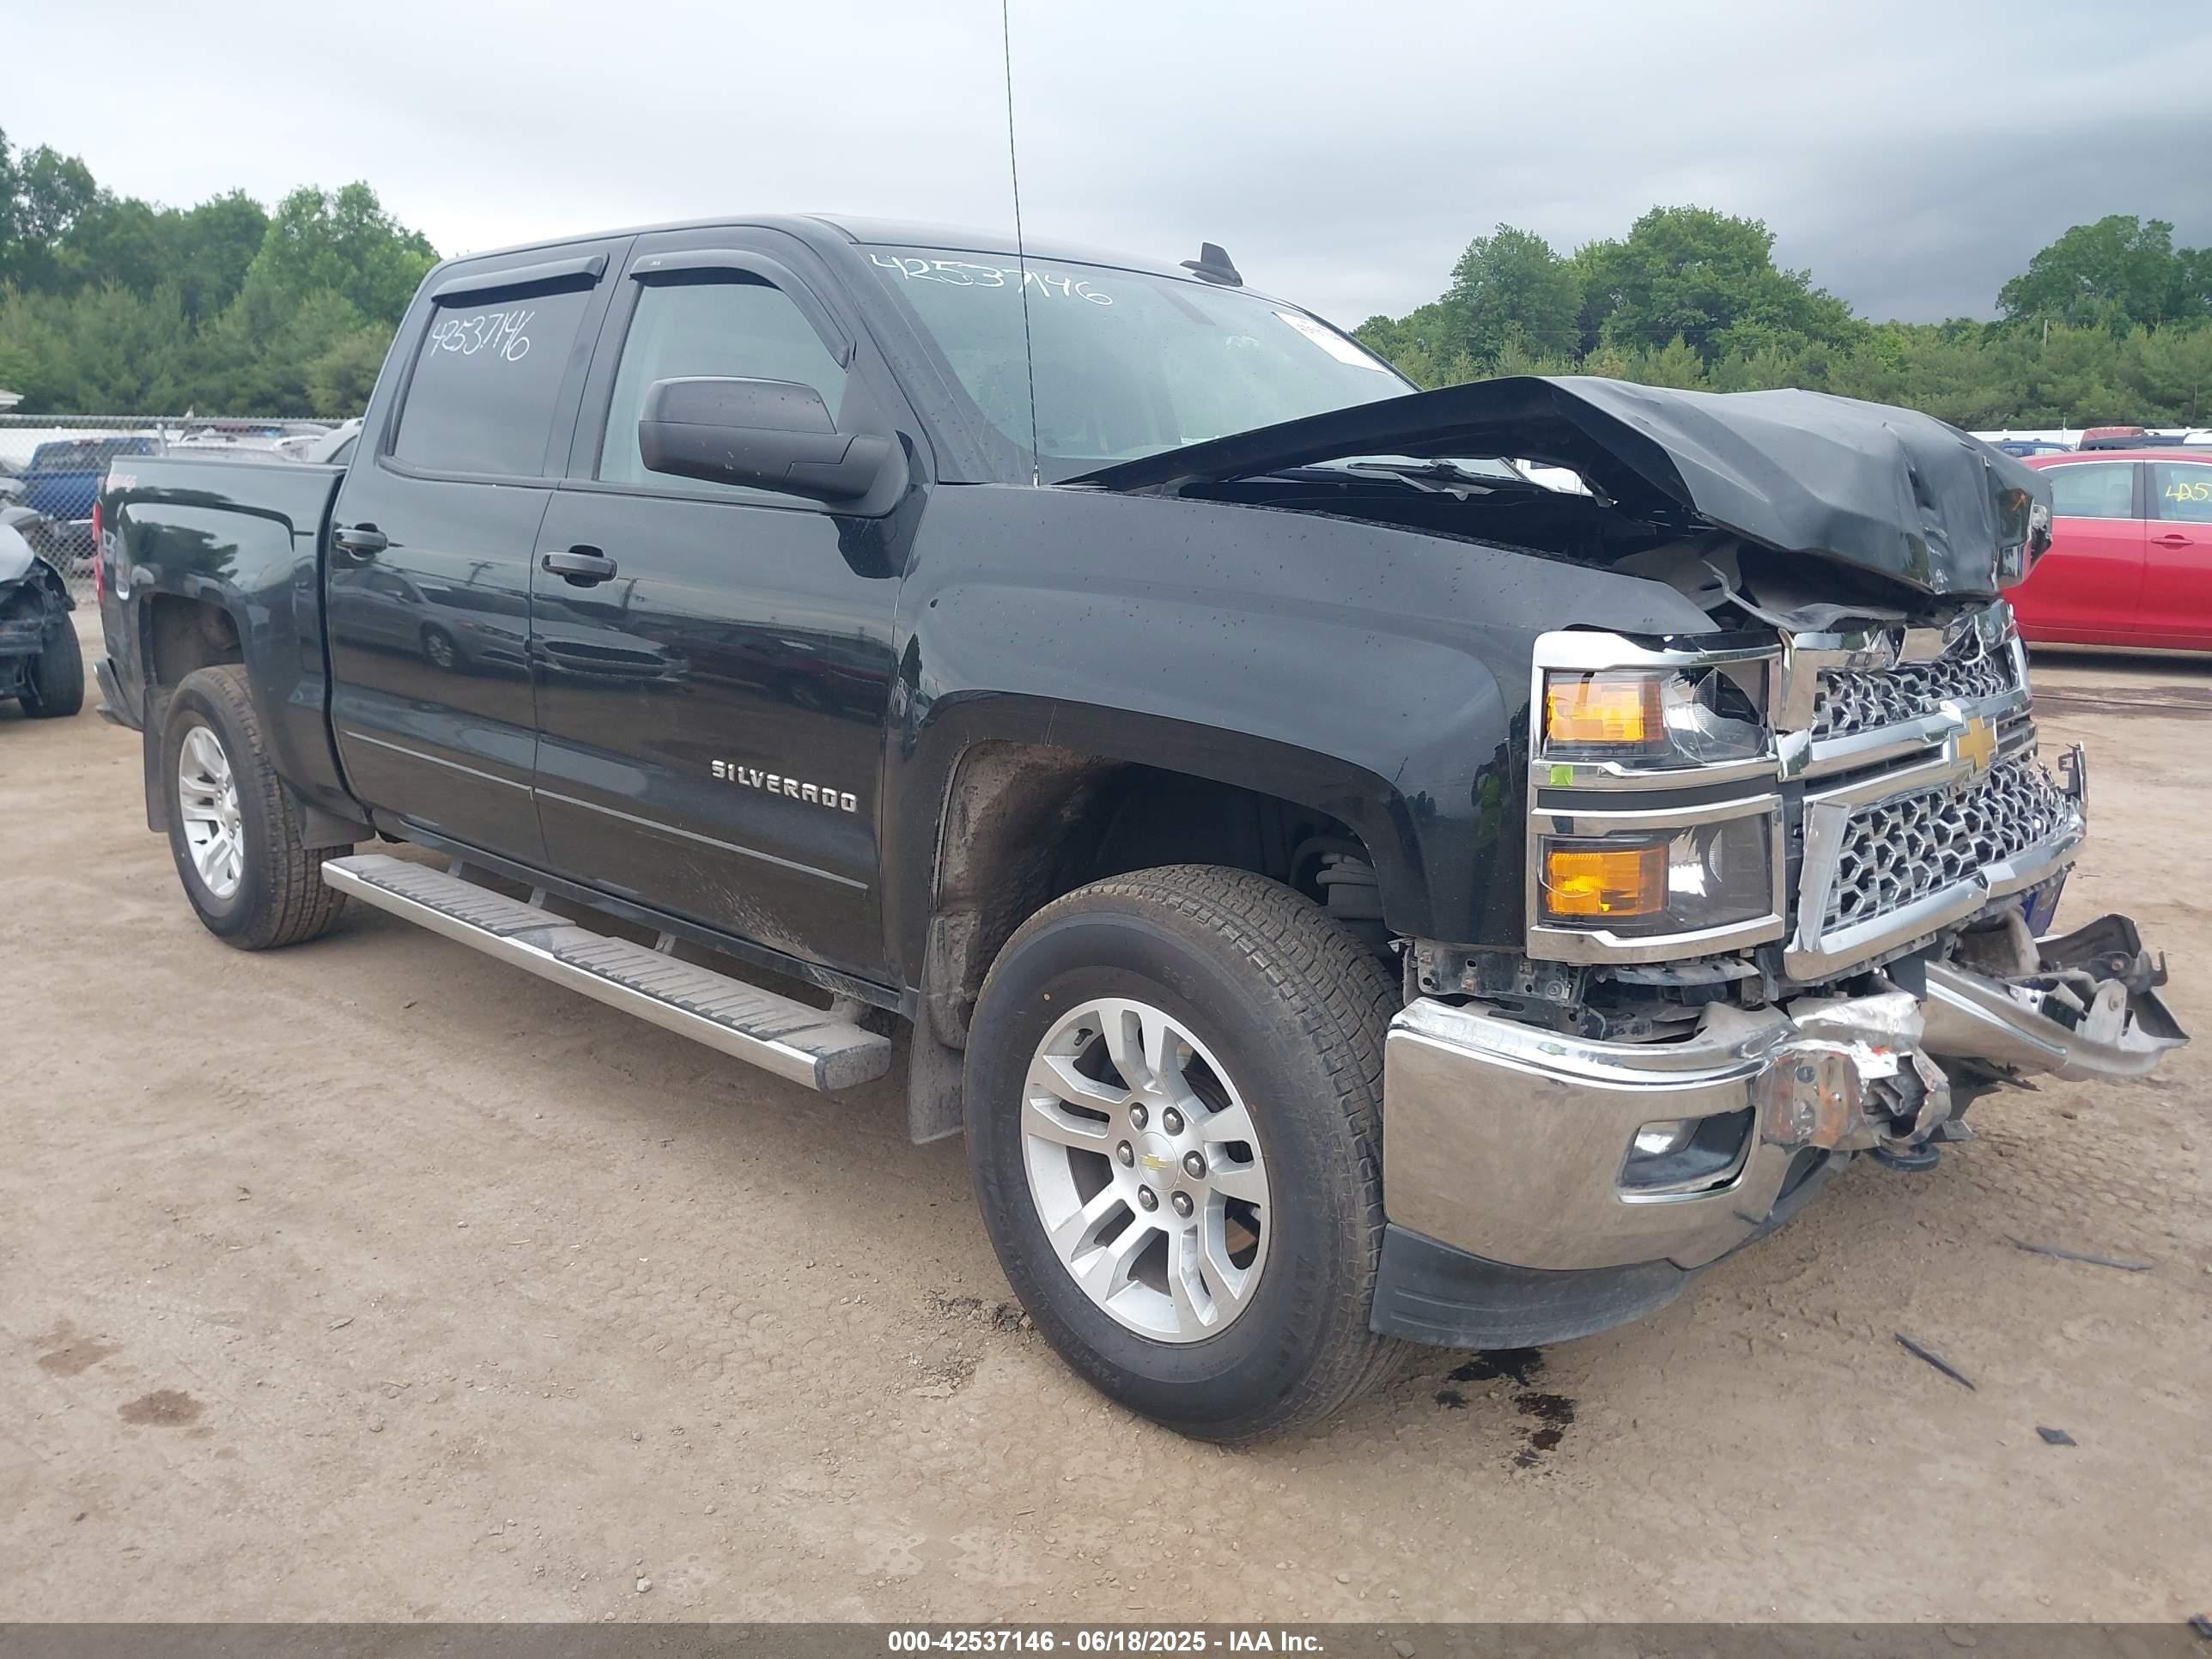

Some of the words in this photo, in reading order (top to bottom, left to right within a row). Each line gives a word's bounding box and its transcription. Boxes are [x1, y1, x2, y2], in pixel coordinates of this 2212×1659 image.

[870, 253, 1114, 306] 42537146
[2165, 483, 2212, 501] 425
[711, 759, 859, 813] SILVERADO
